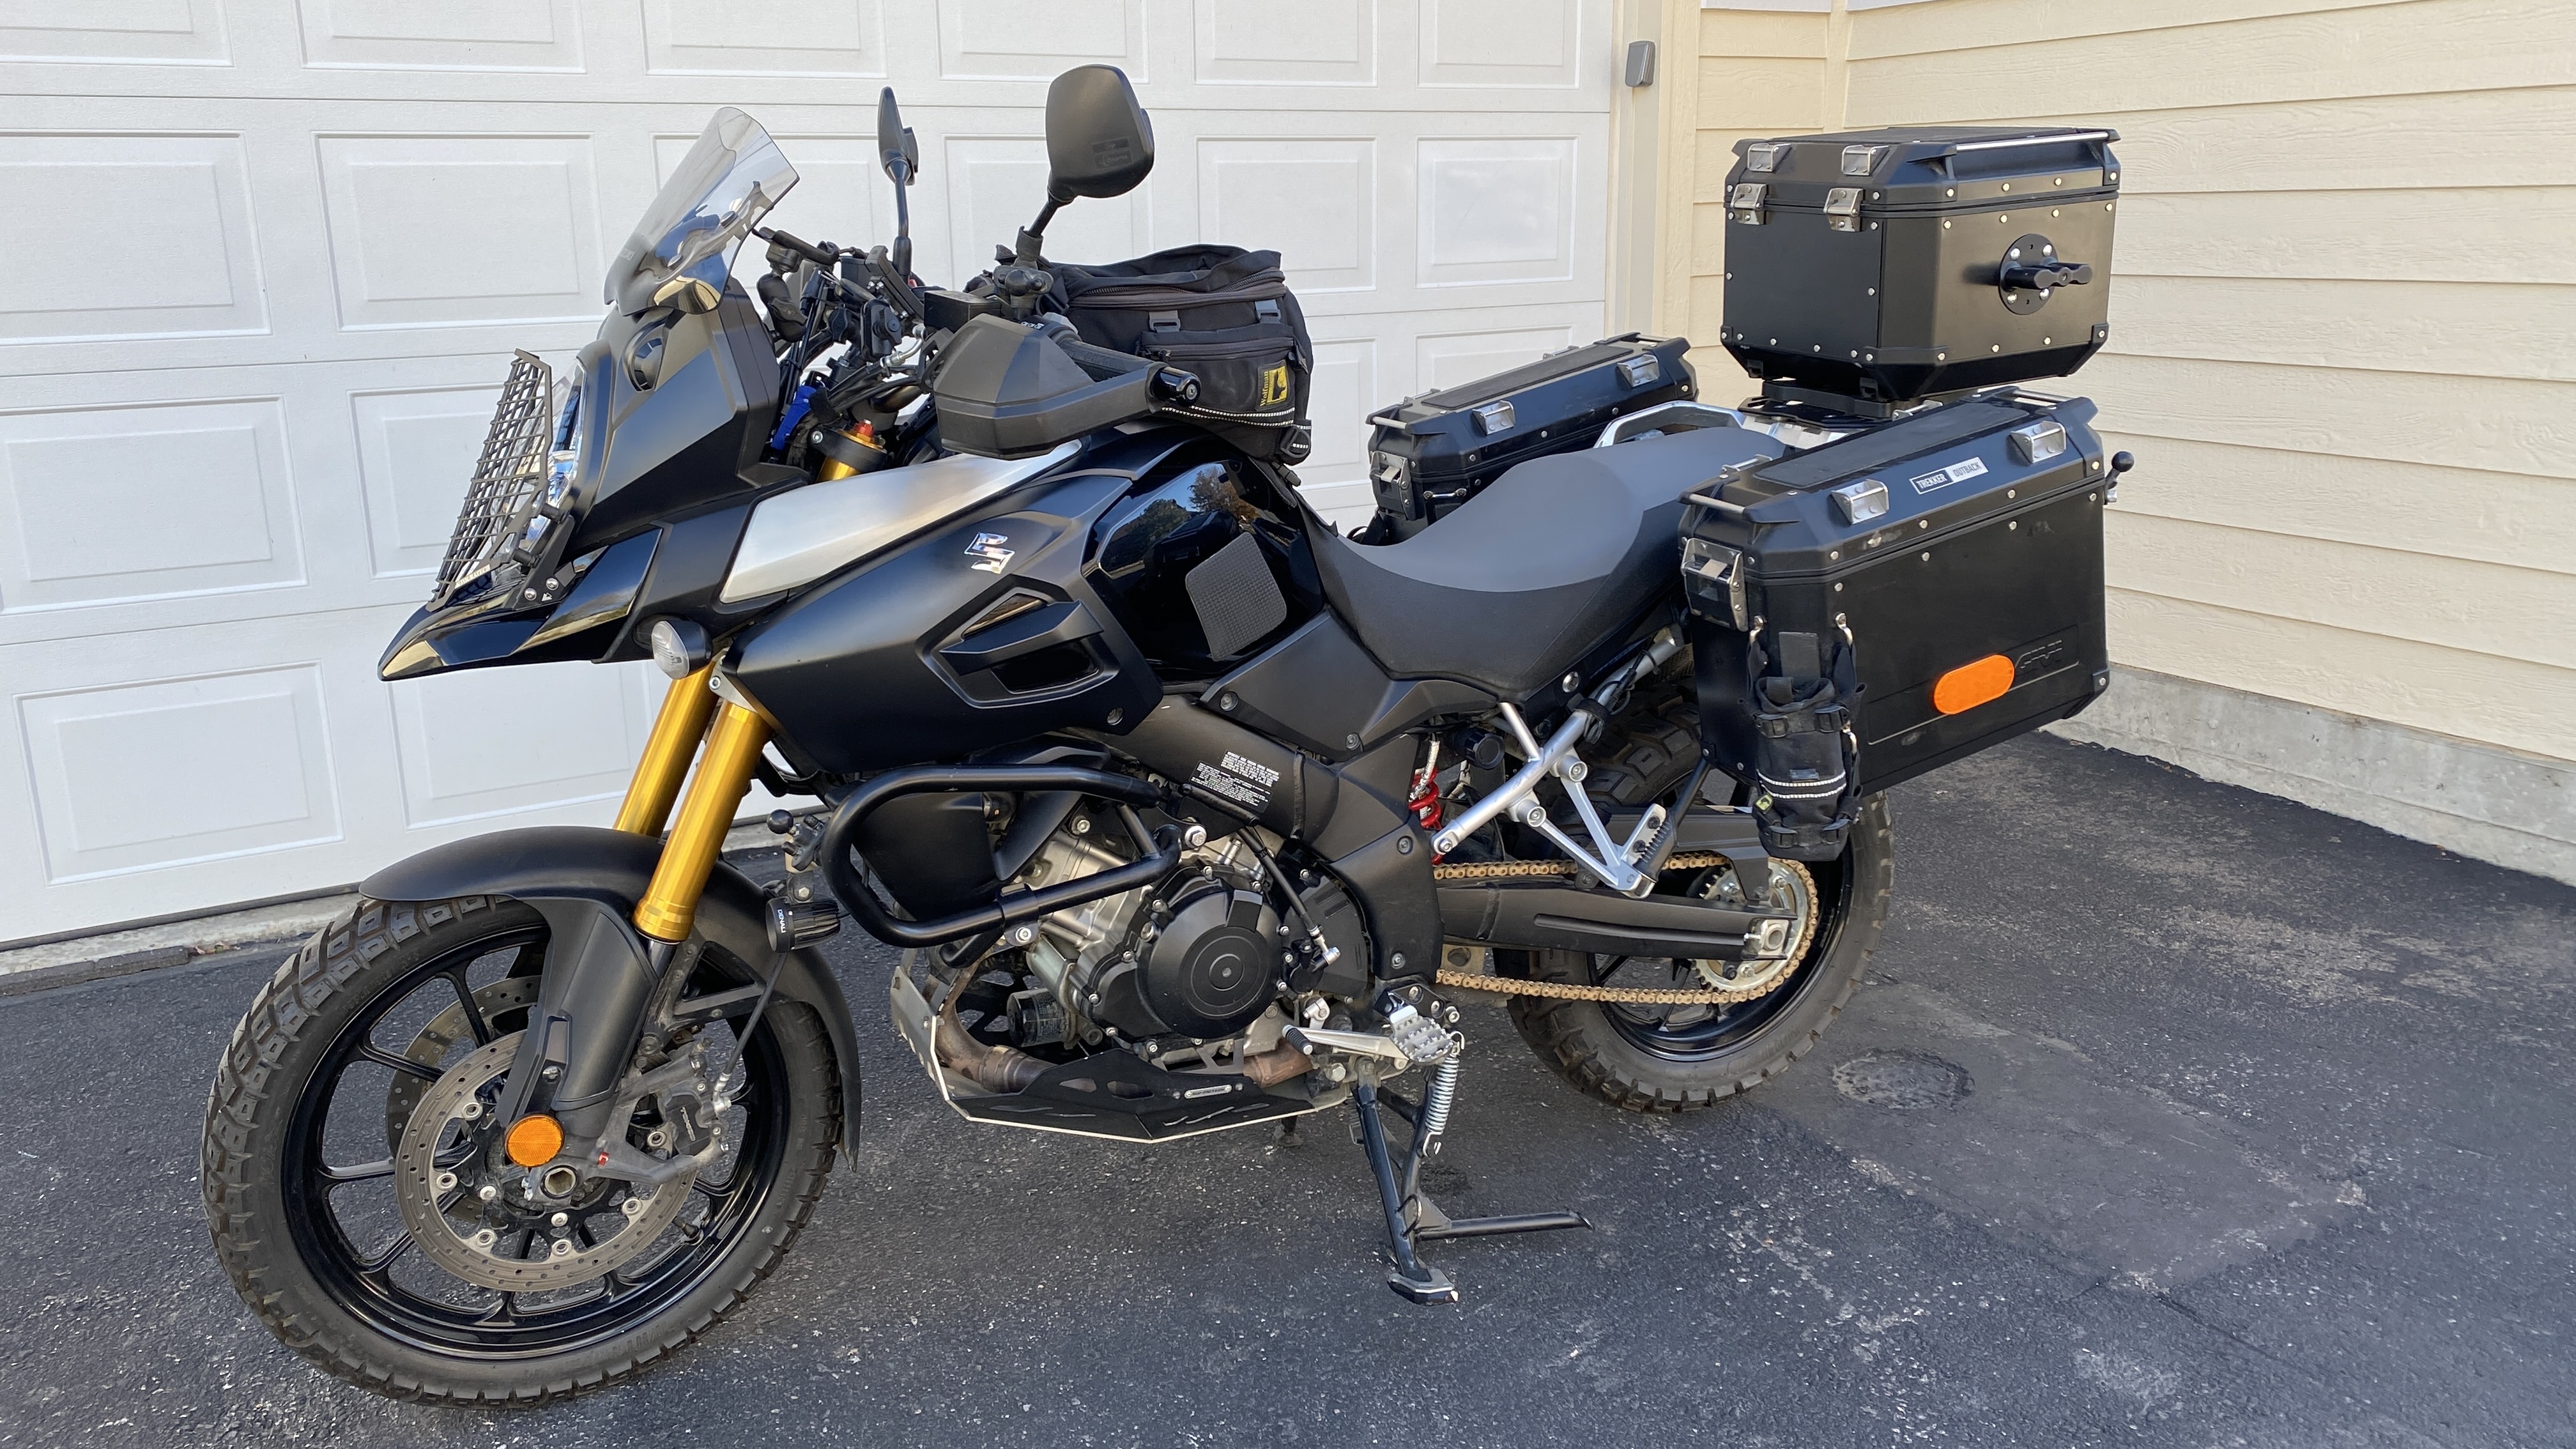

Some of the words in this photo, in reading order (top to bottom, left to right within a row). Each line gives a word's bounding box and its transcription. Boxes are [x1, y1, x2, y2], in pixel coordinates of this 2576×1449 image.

[1259, 371, 1269, 407] Wolfman
[1915, 473, 1948, 489] TREKKER
[1952, 462, 1982, 477] OUTBACK
[776, 909, 786, 933] DENALI
